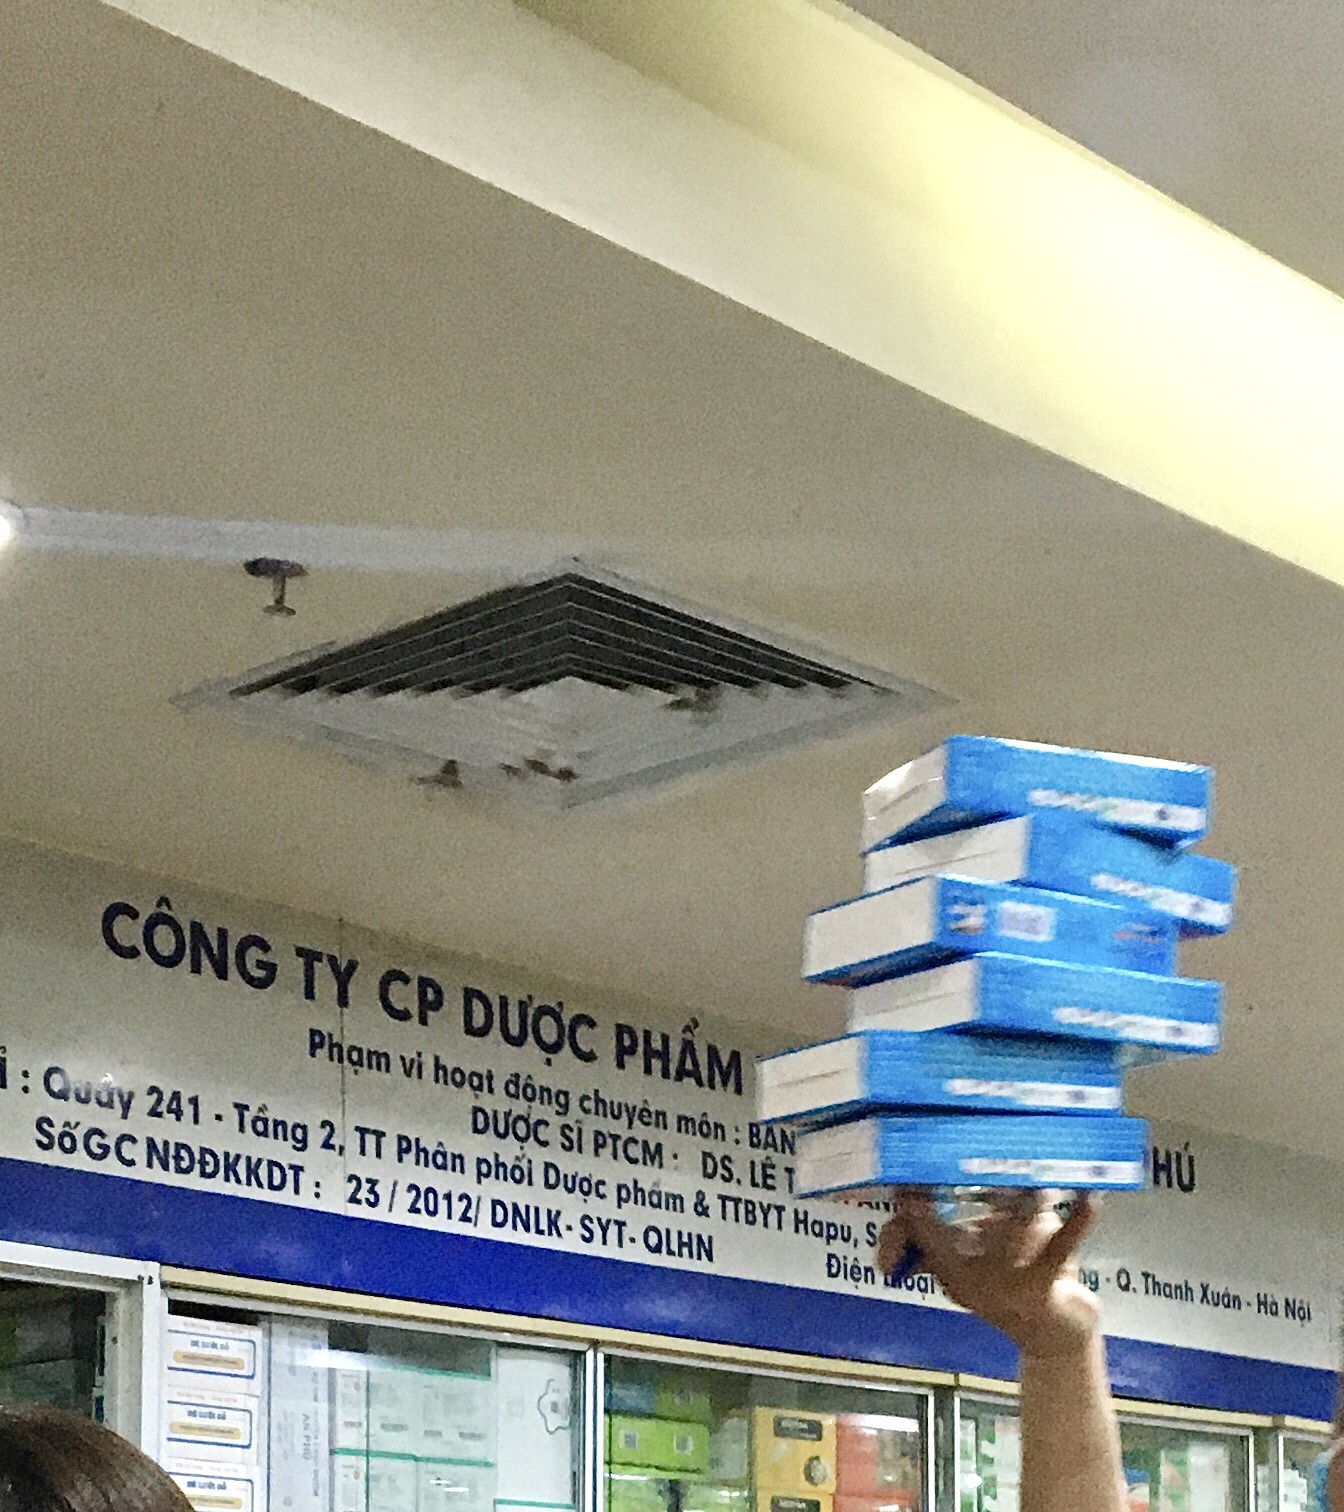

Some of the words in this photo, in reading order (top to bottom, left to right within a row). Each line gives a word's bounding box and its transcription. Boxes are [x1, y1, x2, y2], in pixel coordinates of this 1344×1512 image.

[101, 896, 278, 990] CÔNG
[294, 946, 359, 1008] TY
[378, 967, 444, 1027] CP
[462, 987, 598, 1067] DƯỢC
[614, 1017, 744, 1096] PHẨM
[1152, 1141, 1196, 1193] HÚ
[308, 1027, 391, 1076] Phạm
[399, 1050, 423, 1081] vi
[433, 1054, 495, 1099] hoạt
[503, 1071, 570, 1117] động
[579, 1088, 668, 1130] chuyên
[676, 1112, 726, 1143] môn
[146, 1085, 200, 1126] 241
[232, 1101, 309, 1153] Tầng
[354, 1125, 387, 1160] TT
[396, 1133, 466, 1175] Phân
[476, 1151, 533, 1187] phối
[543, 1160, 607, 1204] Dược
[693, 1189, 711, 1218] &
[716, 1193, 786, 1232] TTBYT
[346, 1173, 380, 1209] 23
[471, 1104, 550, 1150] DƯỢC
[559, 1119, 584, 1154] SĨ
[592, 1129, 664, 1170] PTCM
[749, 1155, 777, 1191] LÊ
[783, 1166, 796, 1195] T
[825, 1252, 876, 1290] Điện
[1140, 1269, 1194, 1305] Thanh
[1256, 1291, 1279, 1317] Hà
[1284, 1297, 1312, 1328] Nội
